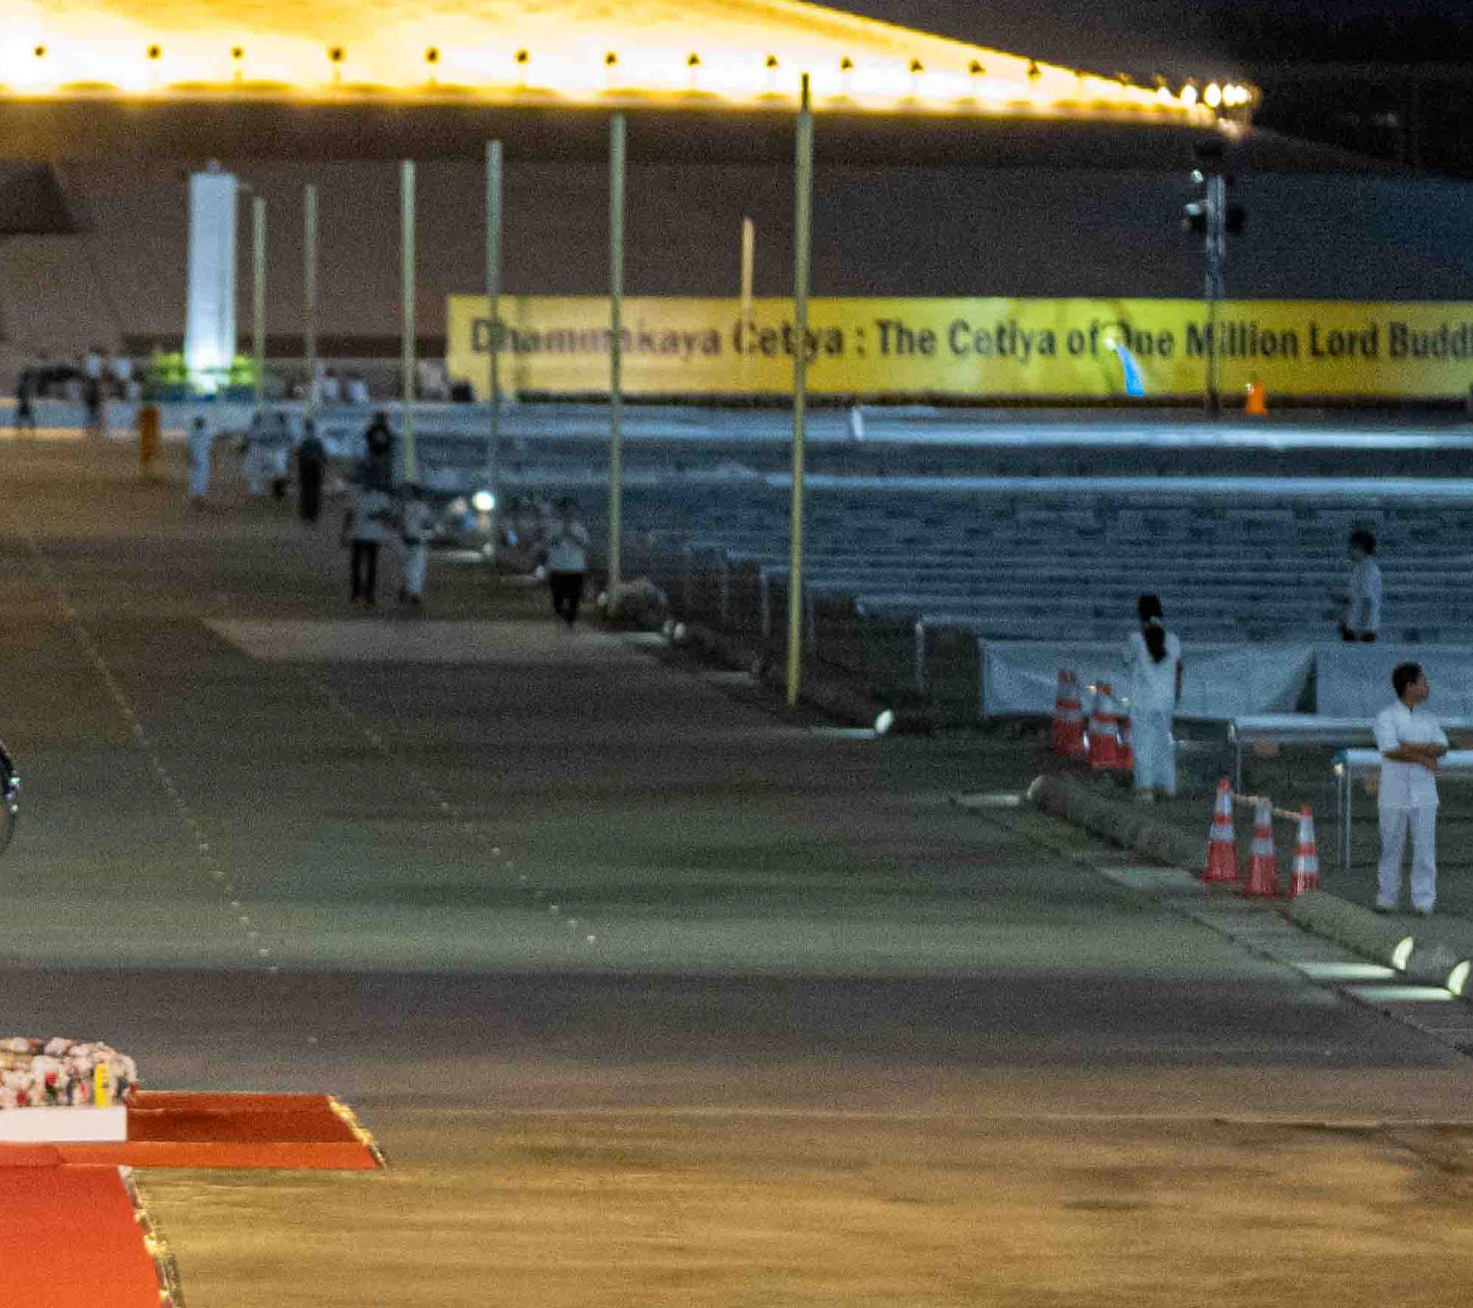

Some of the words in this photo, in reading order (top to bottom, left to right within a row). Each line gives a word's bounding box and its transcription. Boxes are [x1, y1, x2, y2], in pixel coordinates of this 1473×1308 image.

[733, 318, 843, 364] Cetya
[876, 319, 938, 356] The
[950, 319, 1054, 364] Cetiya
[1067, 320, 1099, 356] of
[1186, 321, 1299, 357] Million
[1309, 322, 1380, 358] Lord
